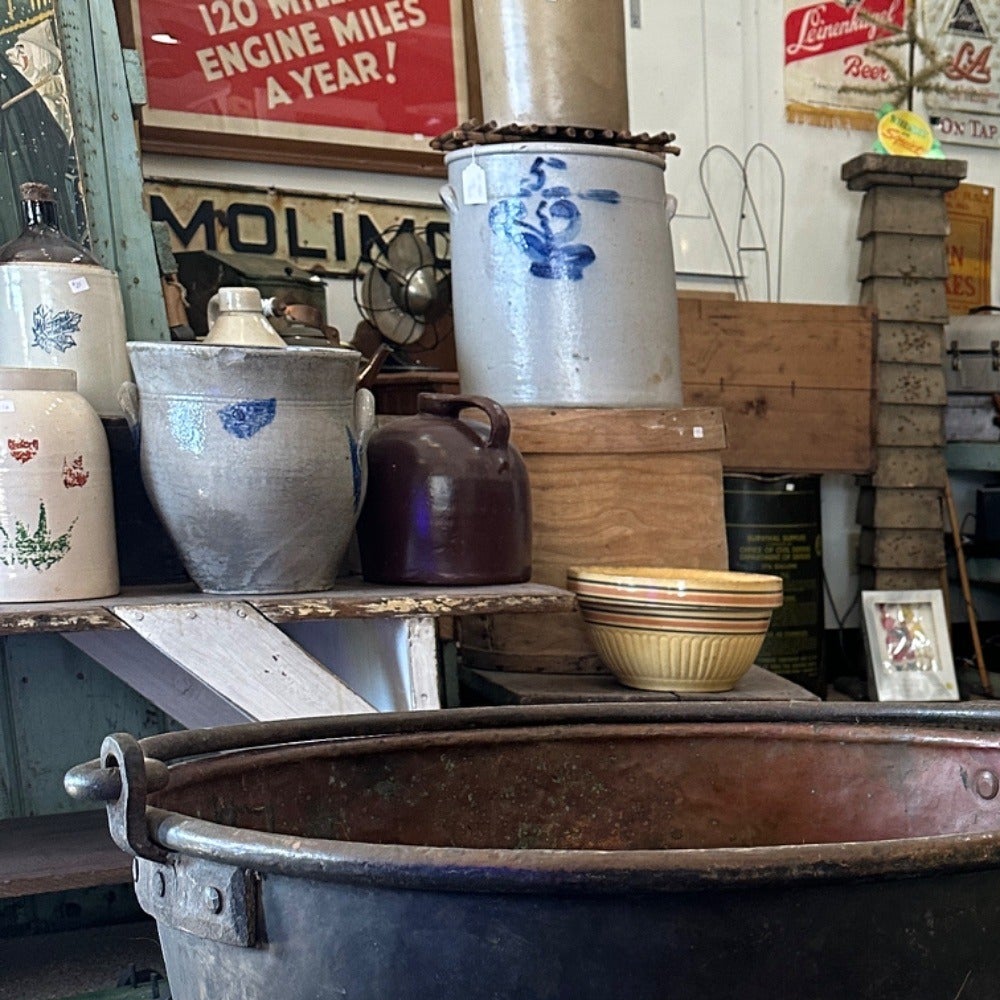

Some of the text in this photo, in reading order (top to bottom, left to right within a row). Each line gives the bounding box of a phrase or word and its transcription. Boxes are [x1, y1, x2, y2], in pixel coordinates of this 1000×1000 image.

[196, 0, 427, 83] ENGINE MILES
[198, 0, 259, 36] 120
[266, 40, 397, 109] A YEAR!
[843, 54, 890, 82] Beer
